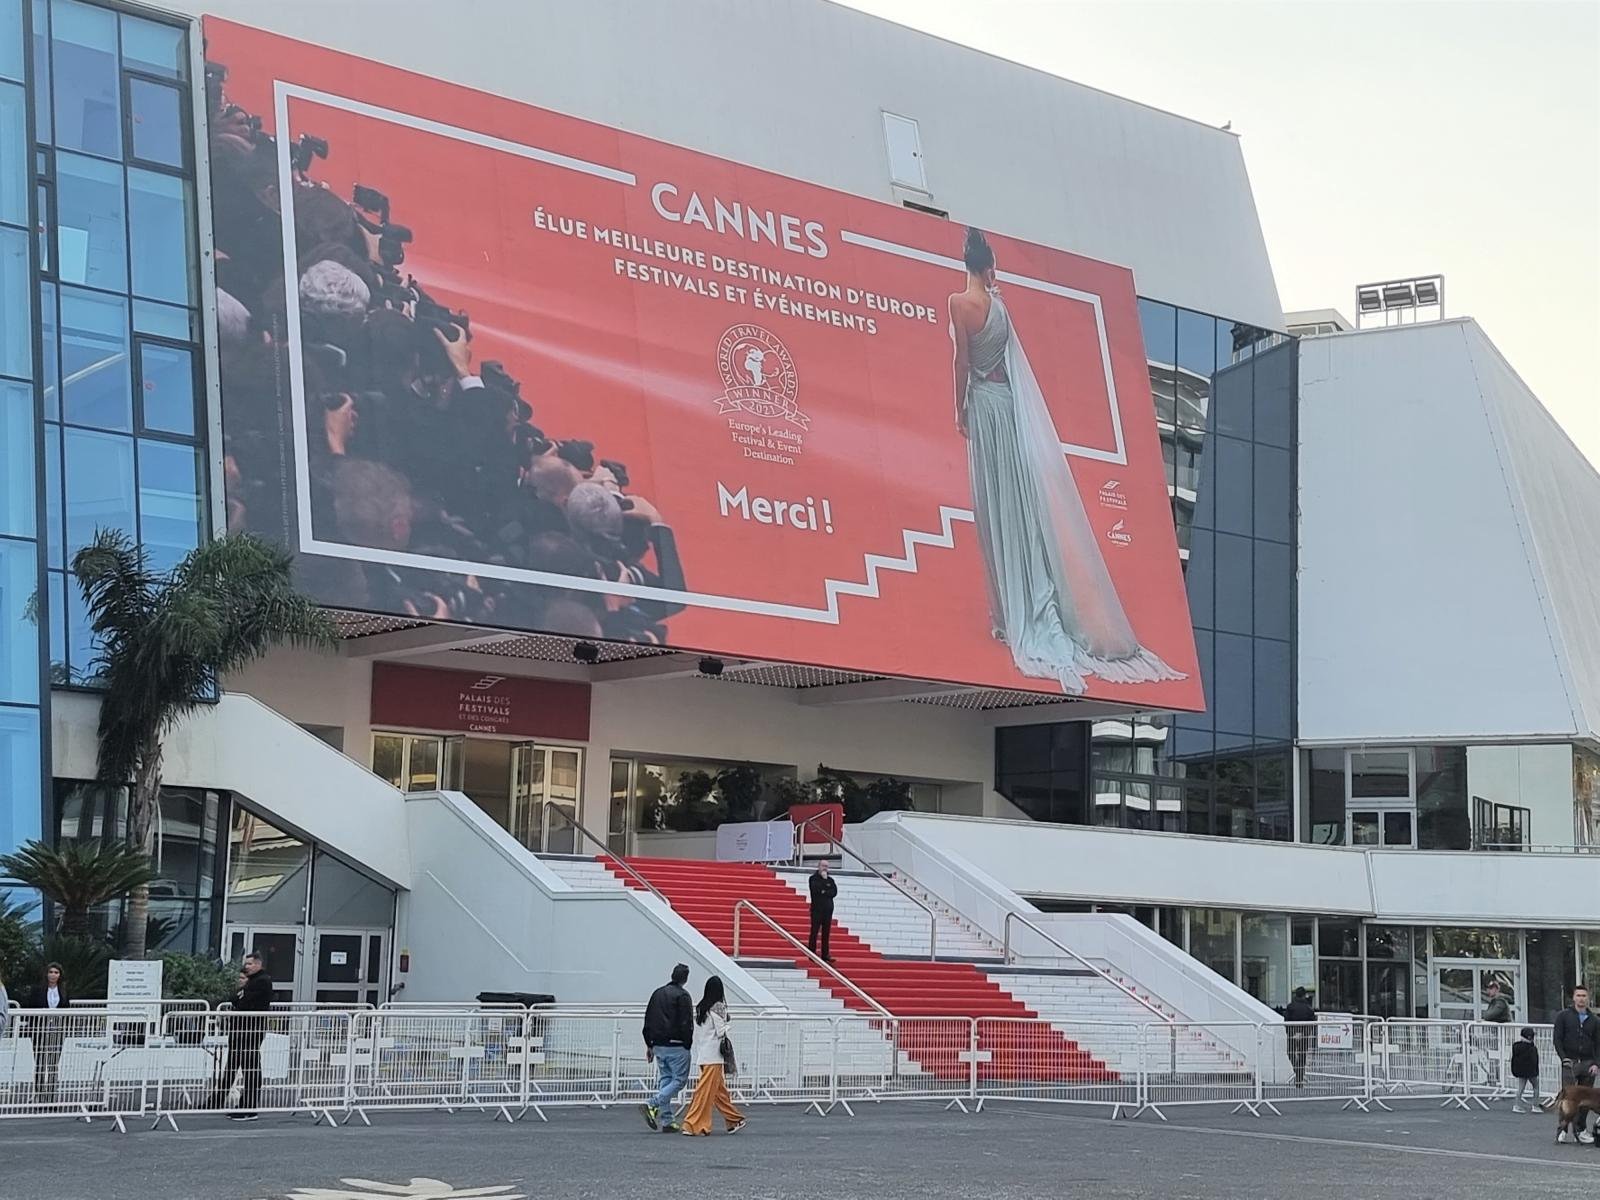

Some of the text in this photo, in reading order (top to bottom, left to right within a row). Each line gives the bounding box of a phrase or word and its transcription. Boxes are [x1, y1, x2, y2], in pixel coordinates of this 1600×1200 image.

[650, 182, 829, 259] CANNES
[534, 206, 937, 324] ÉLUE MEILLEURE DESTINATION D'EUROPE
[614, 258, 877, 335] FESTIVALS ET ÉVÉNEMENTS
[719, 326, 797, 398] WORLD TRAVEL AWARDS
[732, 388, 790, 409] WINNER
[748, 401, 776, 415] 2021
[727, 417, 803, 445] Europe's Leading
[731, 431, 802, 455] Festival & Event
[743, 447, 795, 466] Destination
[460, 693, 510, 705] PALAIS DES
[460, 703, 510, 715] FESTIVALS
[470, 724, 496, 732] CANNES
